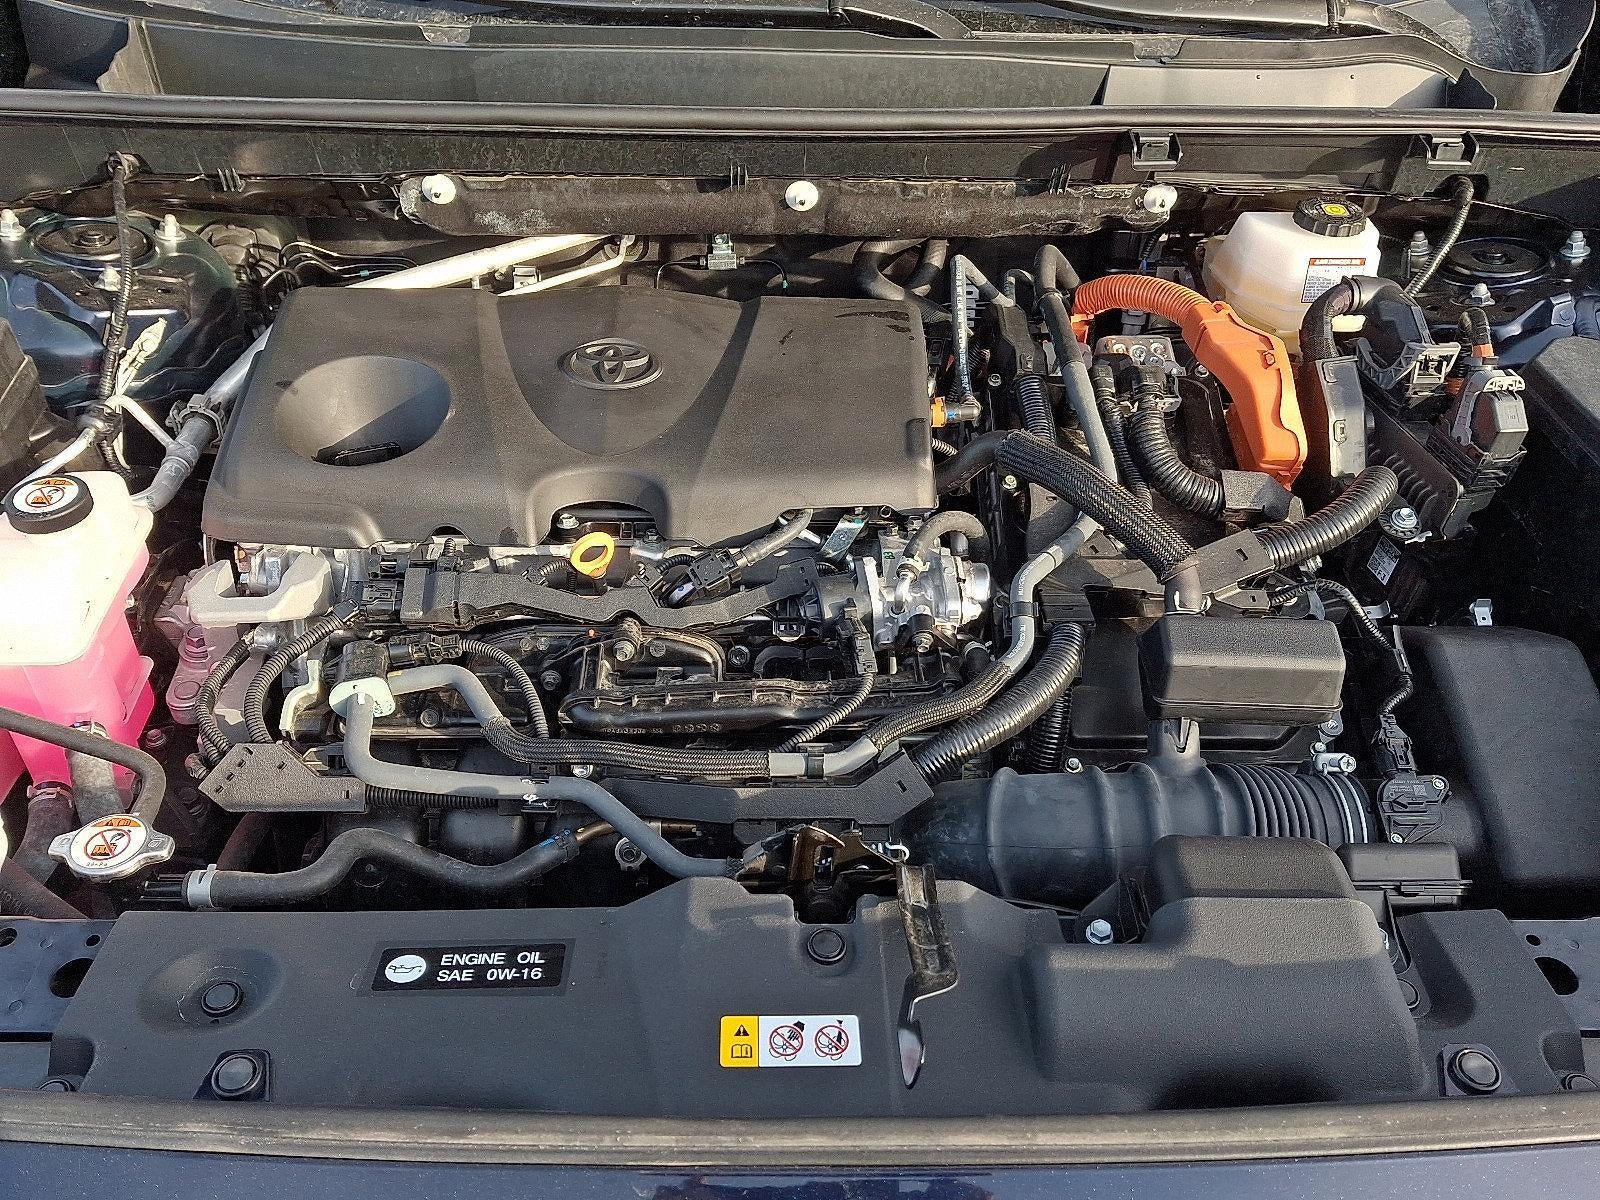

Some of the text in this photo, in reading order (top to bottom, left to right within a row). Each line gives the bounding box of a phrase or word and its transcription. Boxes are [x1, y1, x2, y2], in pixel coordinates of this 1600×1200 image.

[441, 951, 546, 965] ENGINE OIL
[436, 967, 543, 982] SAE 0W-16
